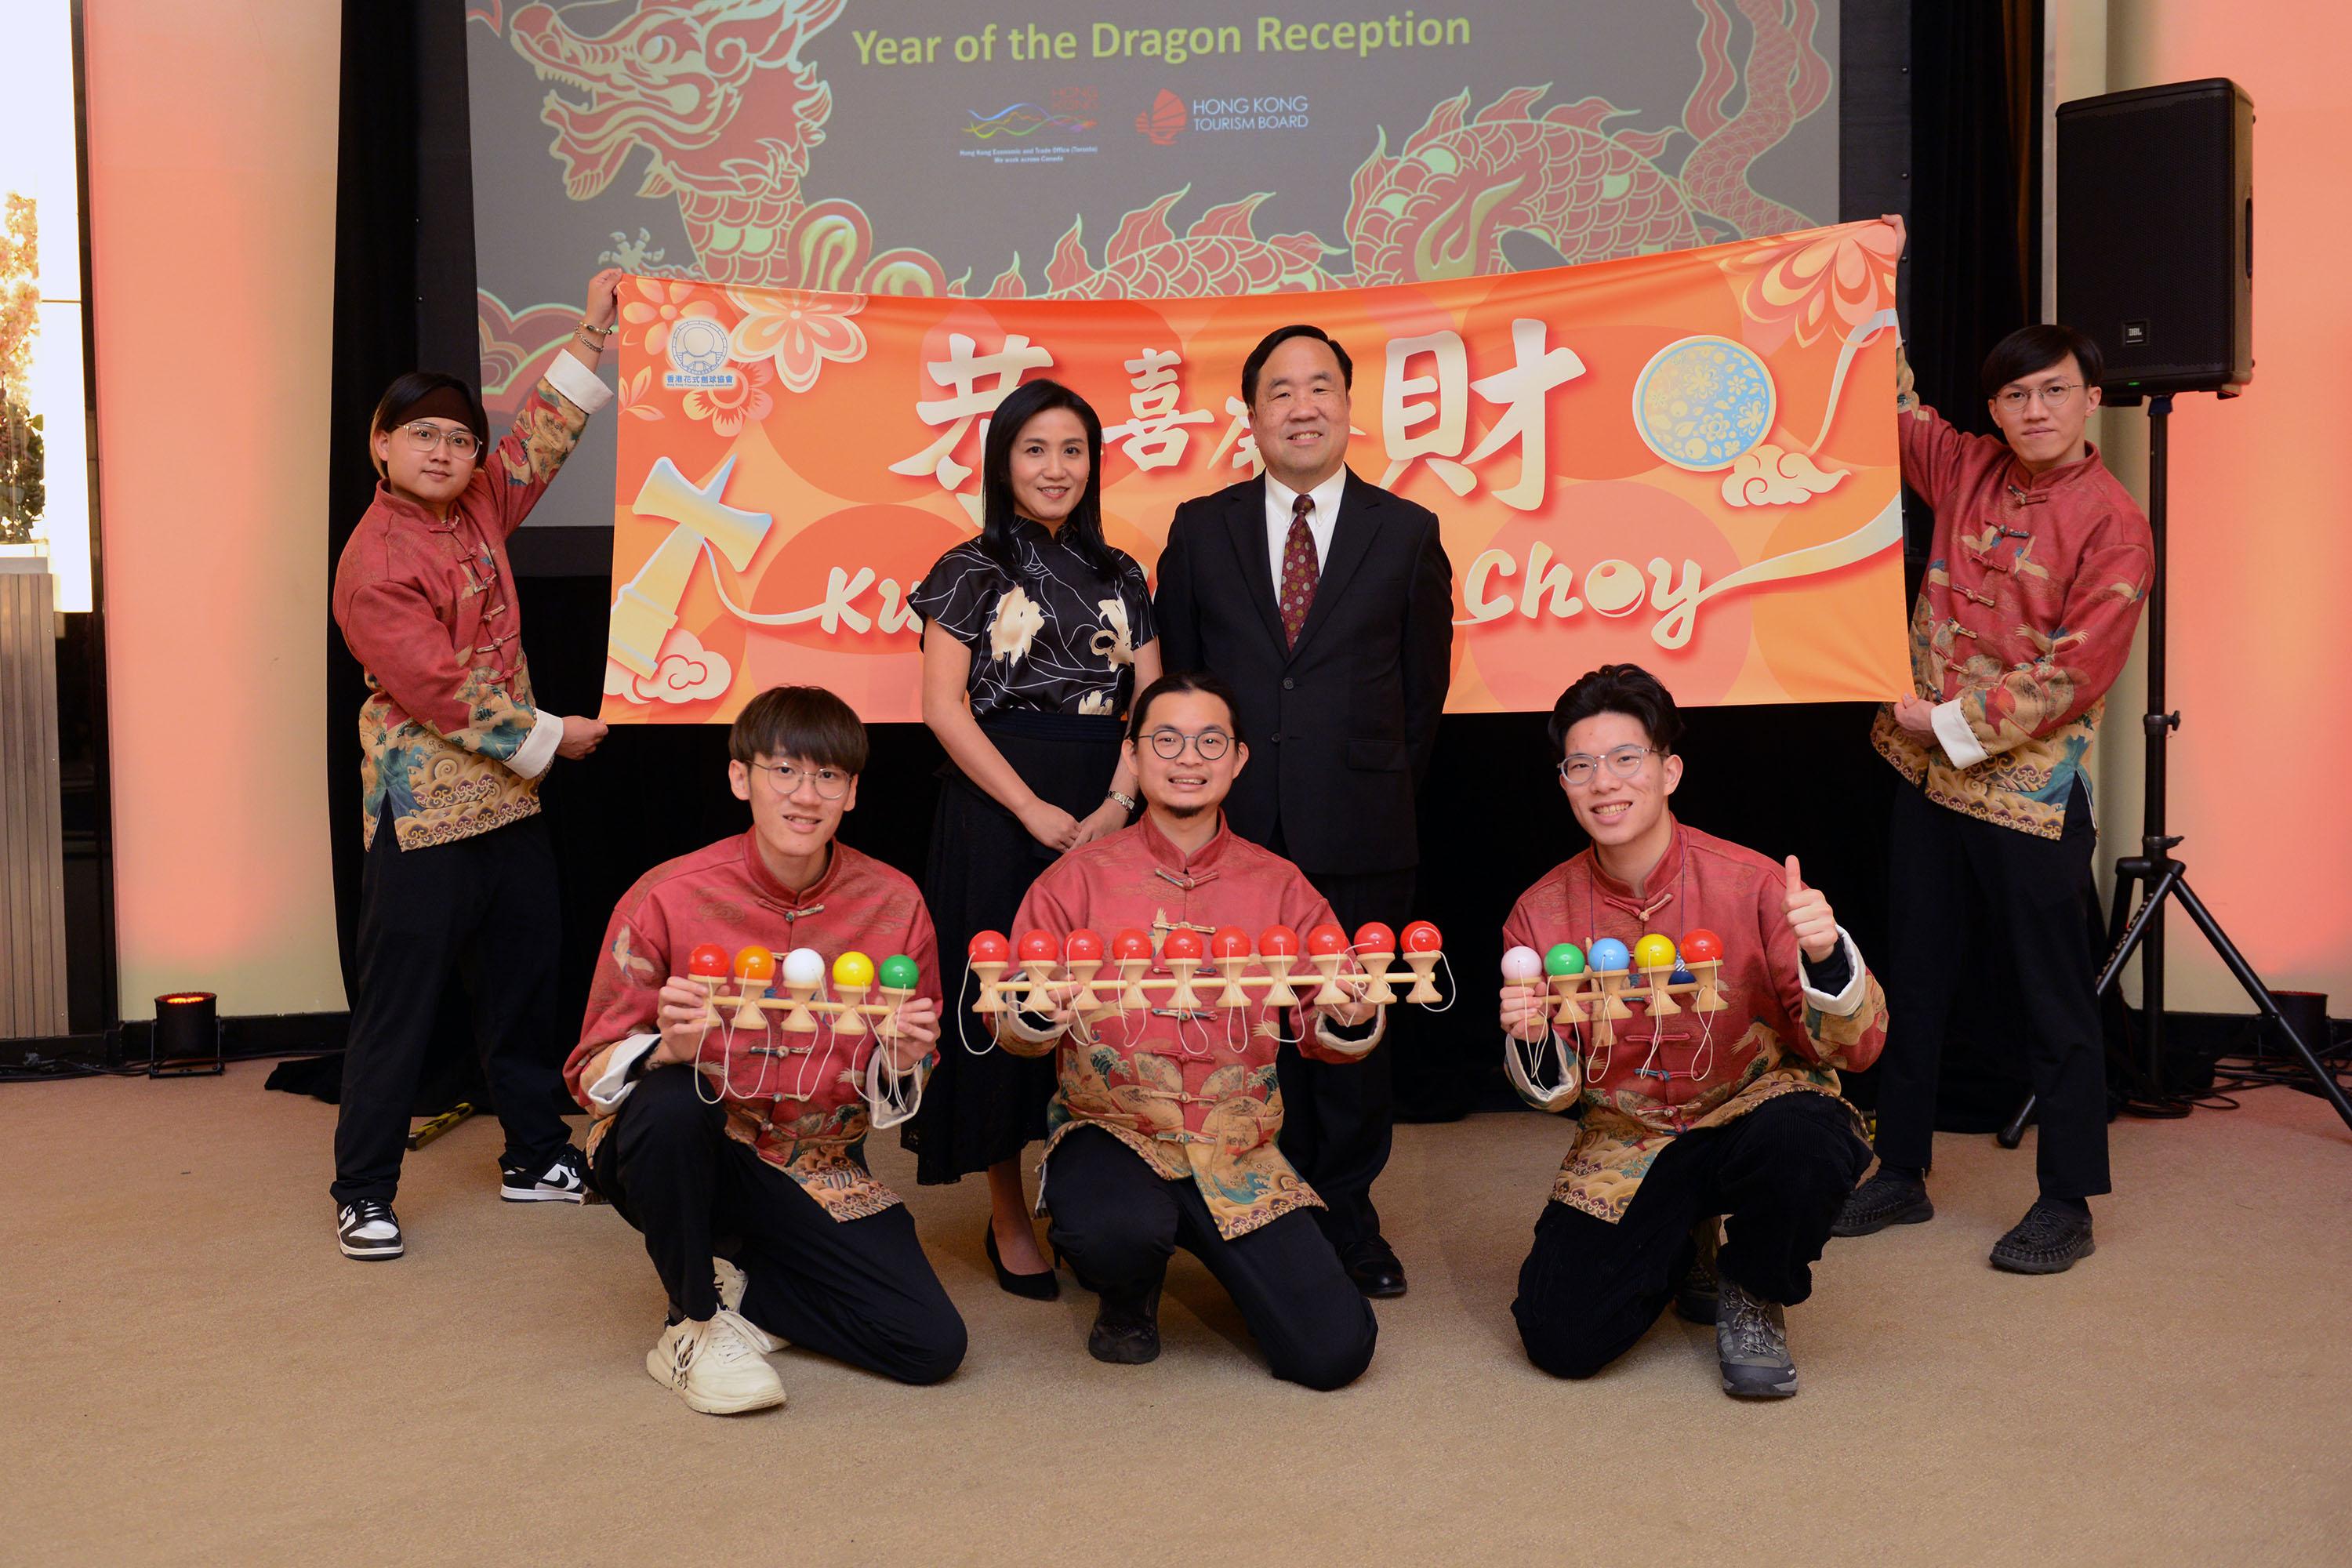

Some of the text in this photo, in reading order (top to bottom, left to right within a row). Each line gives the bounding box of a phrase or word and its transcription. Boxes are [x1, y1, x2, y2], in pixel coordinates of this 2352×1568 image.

[852, 11, 1472, 66] Year of the Dragon Reception
[1193, 95, 1308, 115] HONG KONG
[1194, 114, 1308, 132] TOURISM BOARD
[1052, 145, 1069, 154] Office
[2129, 327, 2143, 336] JBL
[887, 318, 1587, 530] 恭喜財
[1460, 541, 1705, 650] Choy
